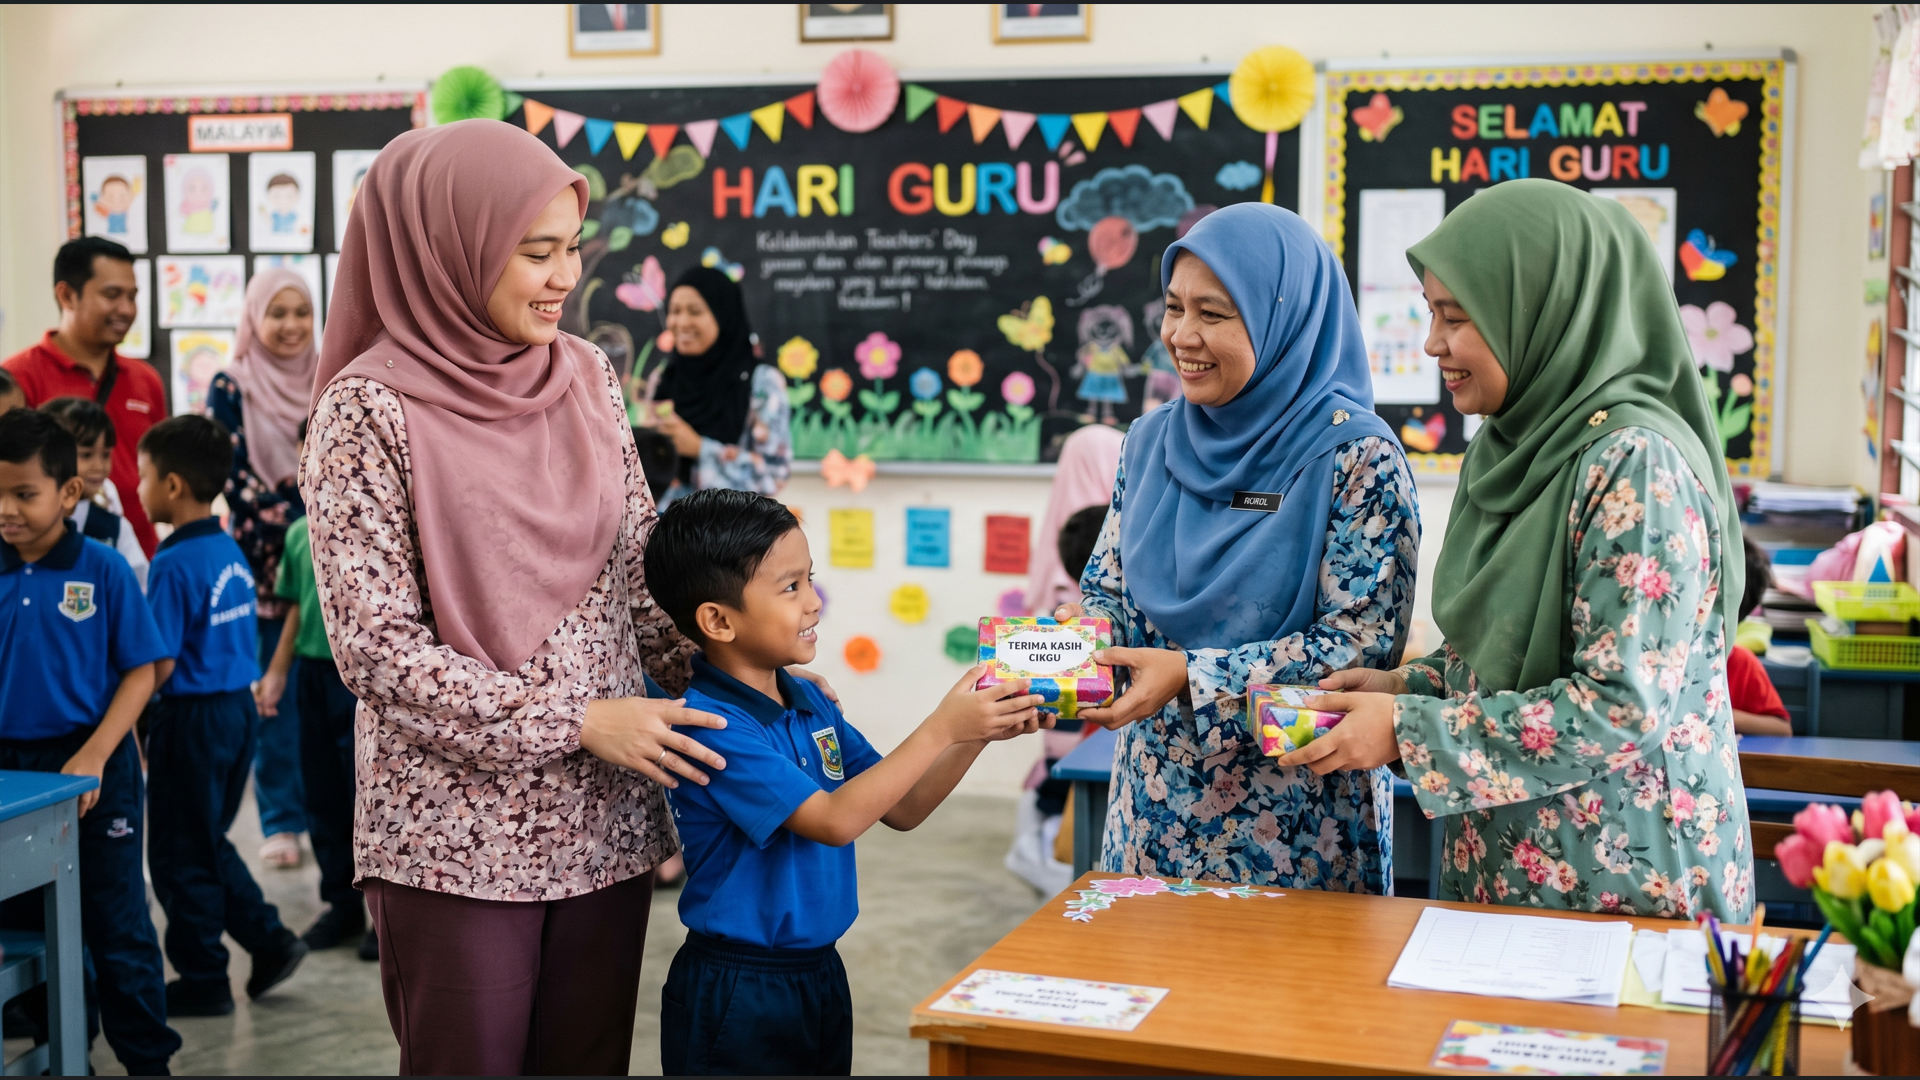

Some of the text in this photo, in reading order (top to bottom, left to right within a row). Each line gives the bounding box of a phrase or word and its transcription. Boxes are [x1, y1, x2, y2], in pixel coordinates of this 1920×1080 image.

[1451, 101, 1648, 140] SELAMAT
[1430, 143, 1670, 183] HARI GURU
[712, 160, 1061, 219] HARI GURU
[943, 227, 978, 256] Day
[1008, 641, 1082, 650] TERIMA KASIH
[1029, 653, 1061, 662] CIKGU
